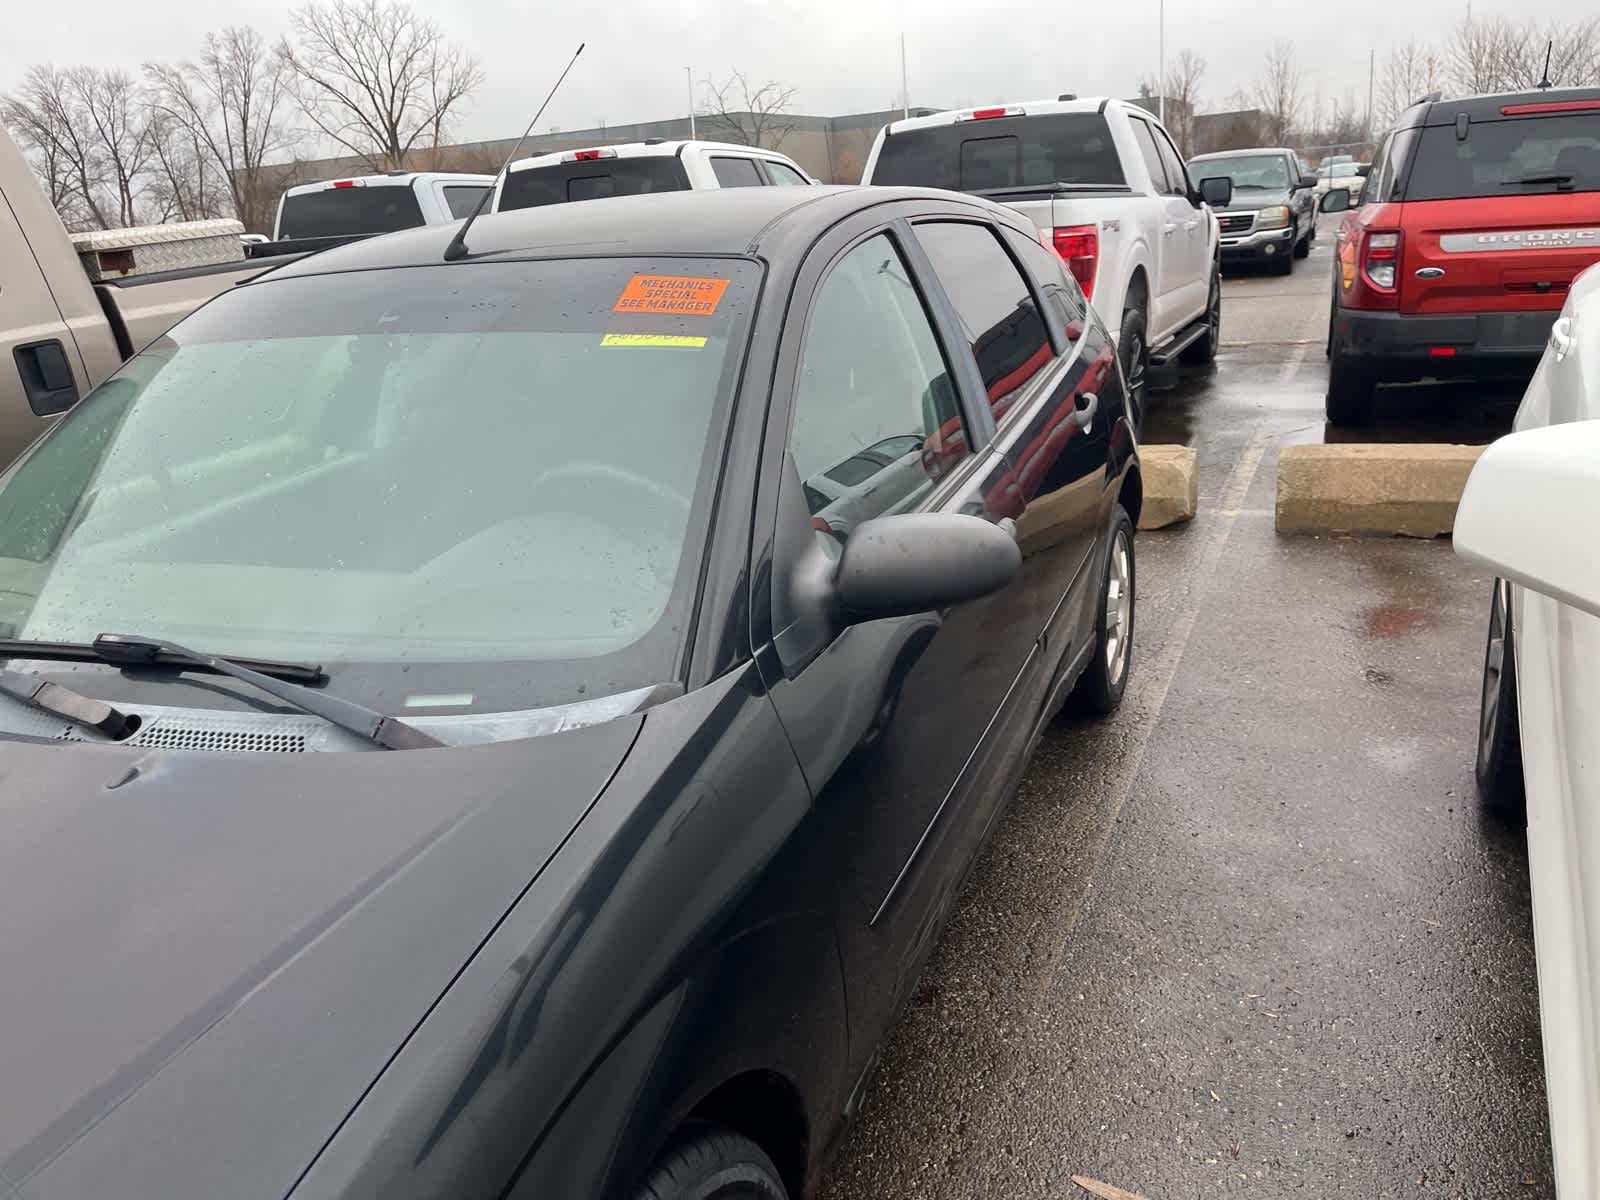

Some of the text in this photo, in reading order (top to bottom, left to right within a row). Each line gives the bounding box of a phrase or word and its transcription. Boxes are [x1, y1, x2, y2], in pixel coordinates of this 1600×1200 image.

[640, 279, 714, 290] MECHANICS
[645, 289, 697, 299] SPECIAL
[620, 298, 712, 311] SEE MANAGER
